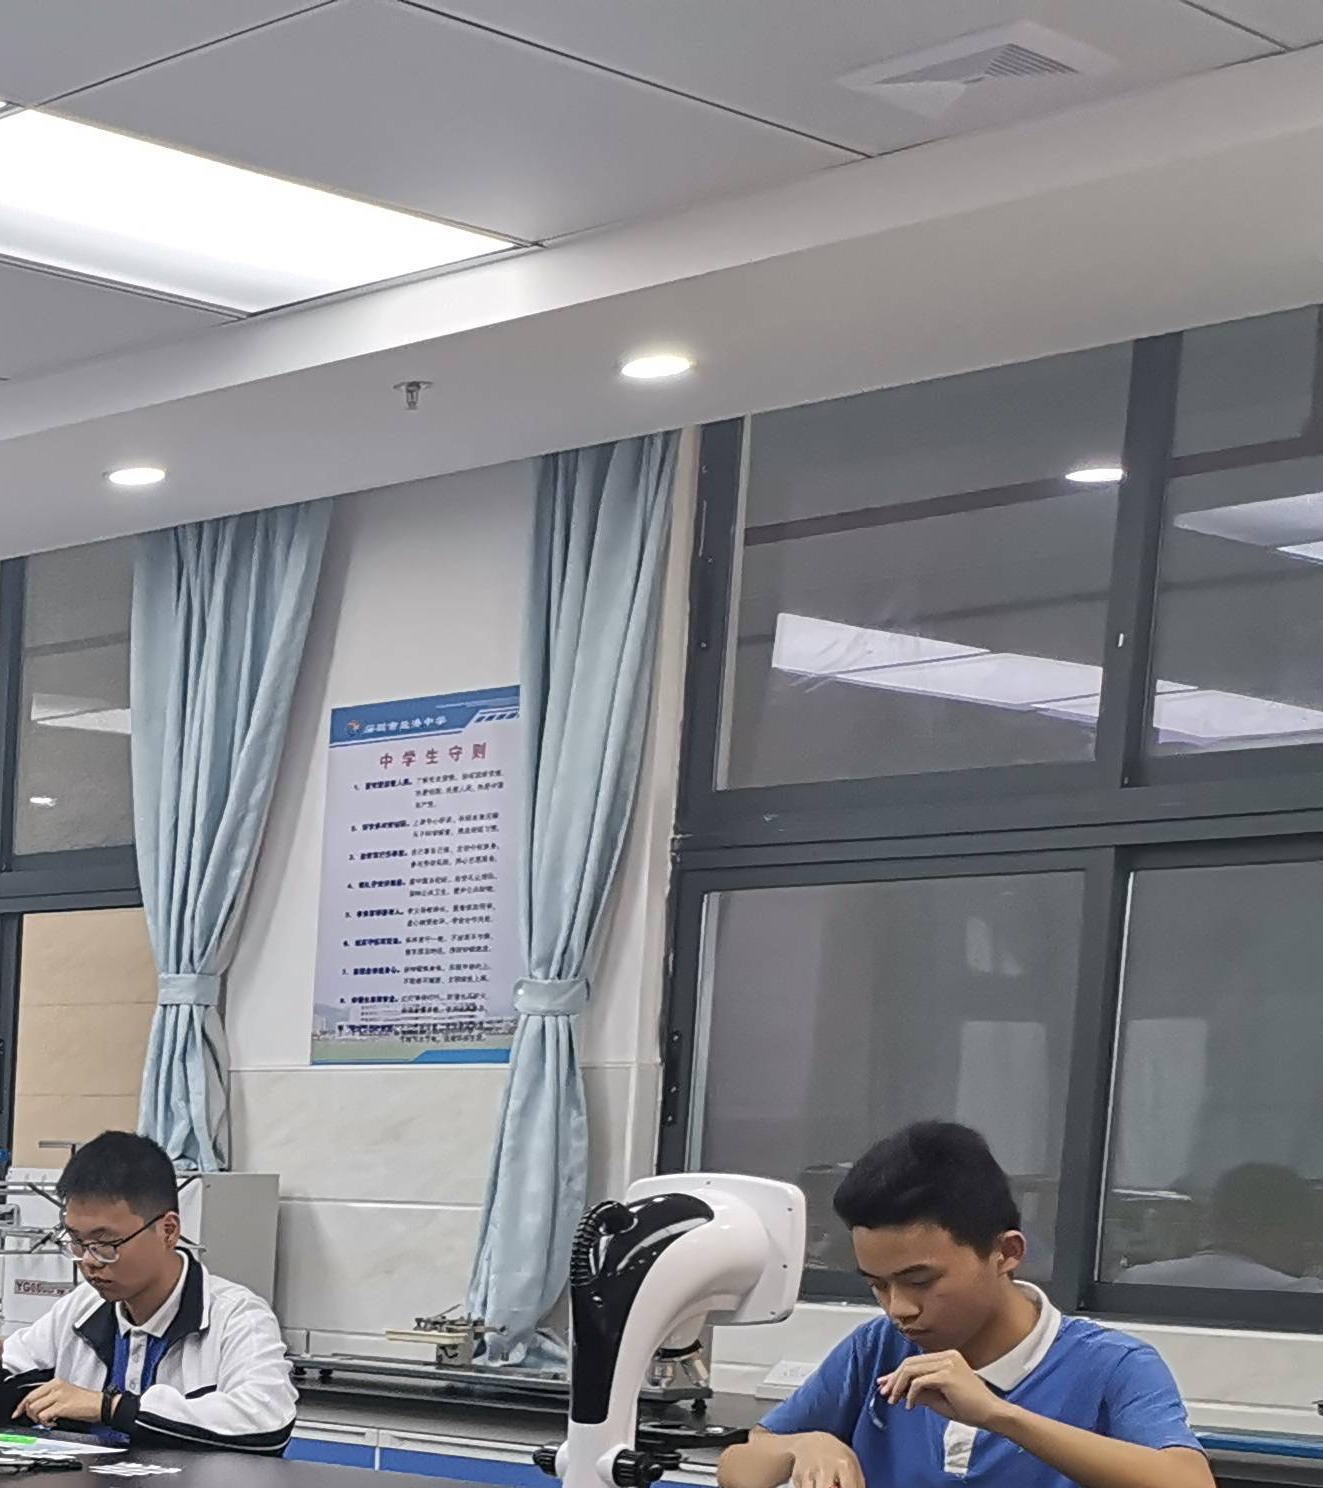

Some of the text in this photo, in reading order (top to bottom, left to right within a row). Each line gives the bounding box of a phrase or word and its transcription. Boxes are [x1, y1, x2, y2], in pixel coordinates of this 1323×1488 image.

[379, 742, 487, 769] 中学生守则
